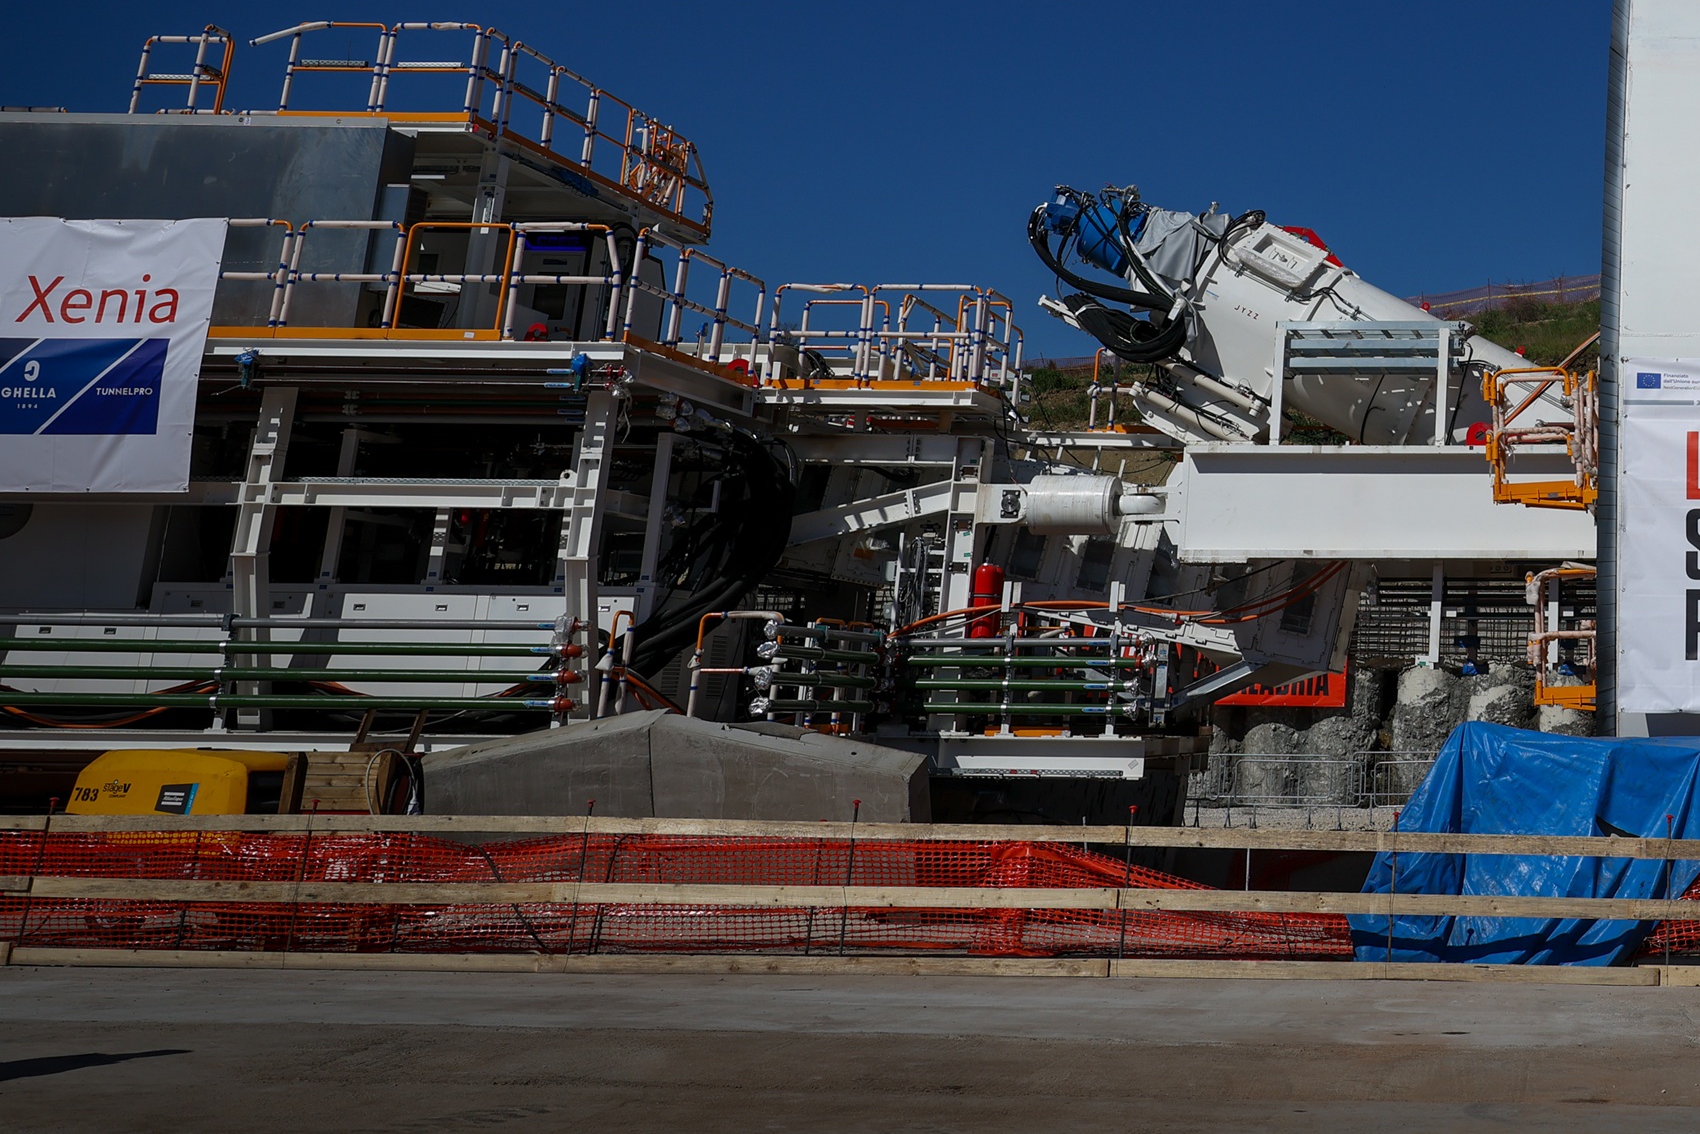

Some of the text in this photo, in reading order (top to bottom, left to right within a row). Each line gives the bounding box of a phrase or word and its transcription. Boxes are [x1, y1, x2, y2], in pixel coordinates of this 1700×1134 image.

[15, 273, 180, 324] Xenia
[1, 387, 57, 398] GHELLA
[96, 387, 153, 396] TUNNELPRO
[74, 787, 99, 802] 783
